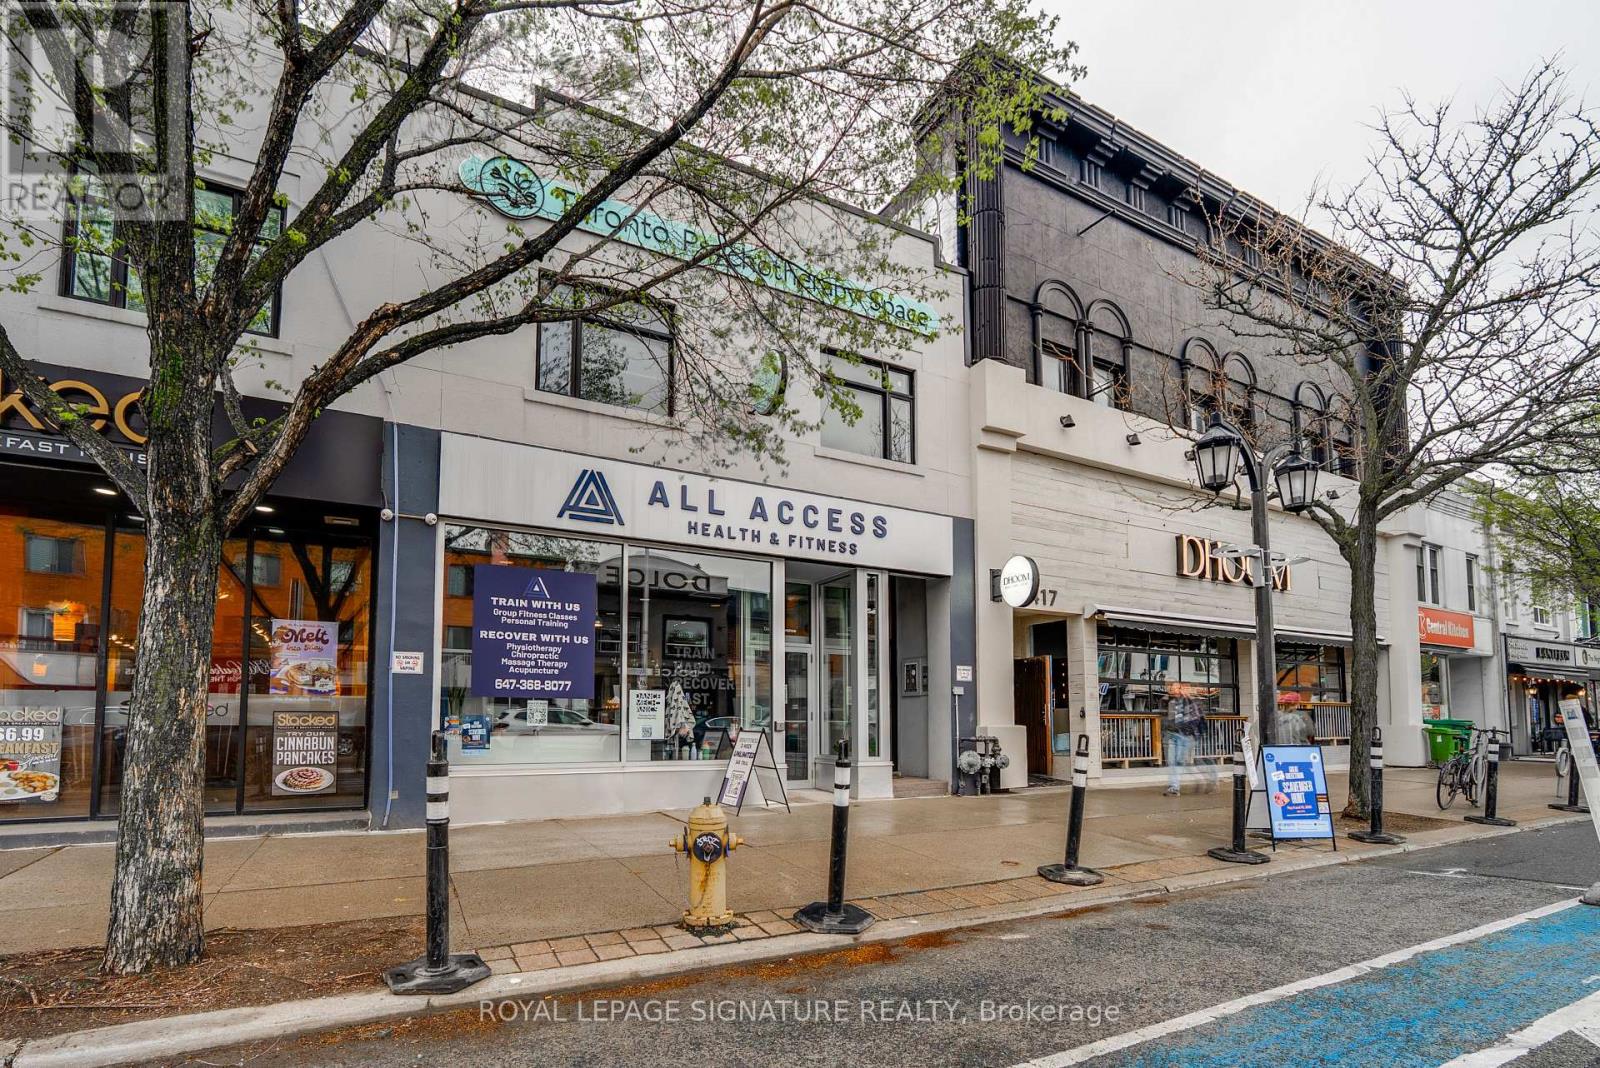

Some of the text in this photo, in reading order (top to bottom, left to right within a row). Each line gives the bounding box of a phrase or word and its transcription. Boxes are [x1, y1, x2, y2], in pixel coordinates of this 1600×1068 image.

[556, 186, 669, 243] Tronto
[648, 480, 888, 539] ALL ACCESS
[687, 521, 858, 556] HEALTH & FITNESS
[490, 597, 581, 611] TRAIN WITH US
[1034, 589, 1058, 607] 17
[493, 608, 578, 621] Group Fitness Classes
[501, 617, 569, 629] Personal Training
[280, 628, 330, 645] Melt
[479, 630, 589, 645] RECOVER WITH US
[506, 643, 562, 654] Physiotherapy
[511, 651, 559, 660] Chiropractic
[674, 646, 716, 660] TRAIN
[501, 658, 568, 669] Massage Therapy
[508, 667, 559, 675] Acupuncture
[495, 679, 572, 691] 647-368-8077
[683, 692, 713, 705] AST.
[277, 713, 336, 726] Stacked
[276, 736, 335, 751] CINNABUN
[276, 751, 335, 765] PANCAKES
